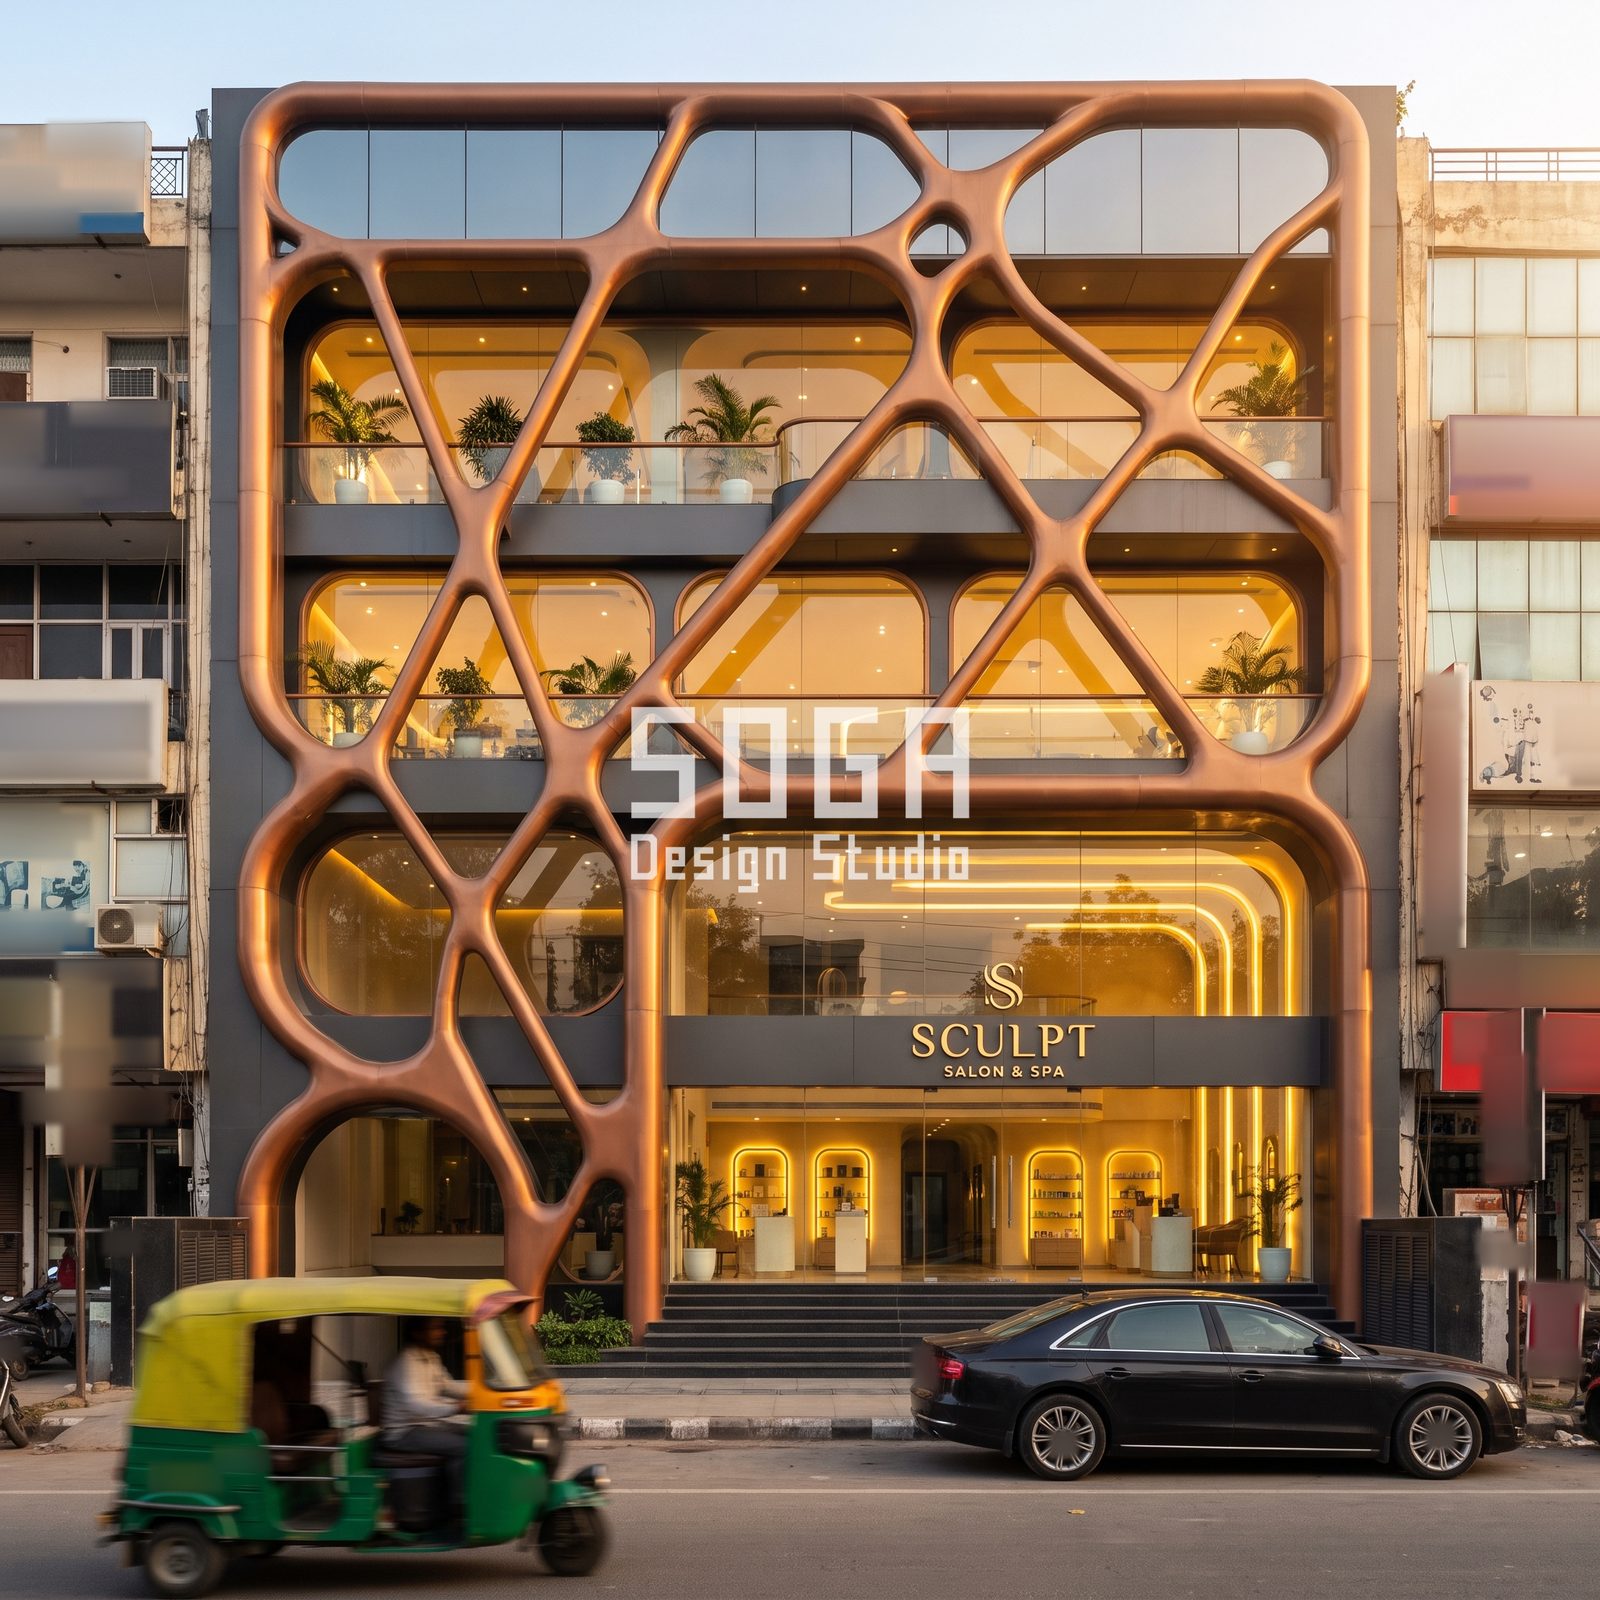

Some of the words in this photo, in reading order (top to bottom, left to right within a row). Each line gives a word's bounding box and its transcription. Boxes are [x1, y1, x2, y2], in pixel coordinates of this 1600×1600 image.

[912, 1023, 1096, 1058] SCULPT
[944, 1065, 1004, 1078] SALON
[1012, 1065, 1023, 1078] &
[1030, 1065, 1065, 1078] SPA
